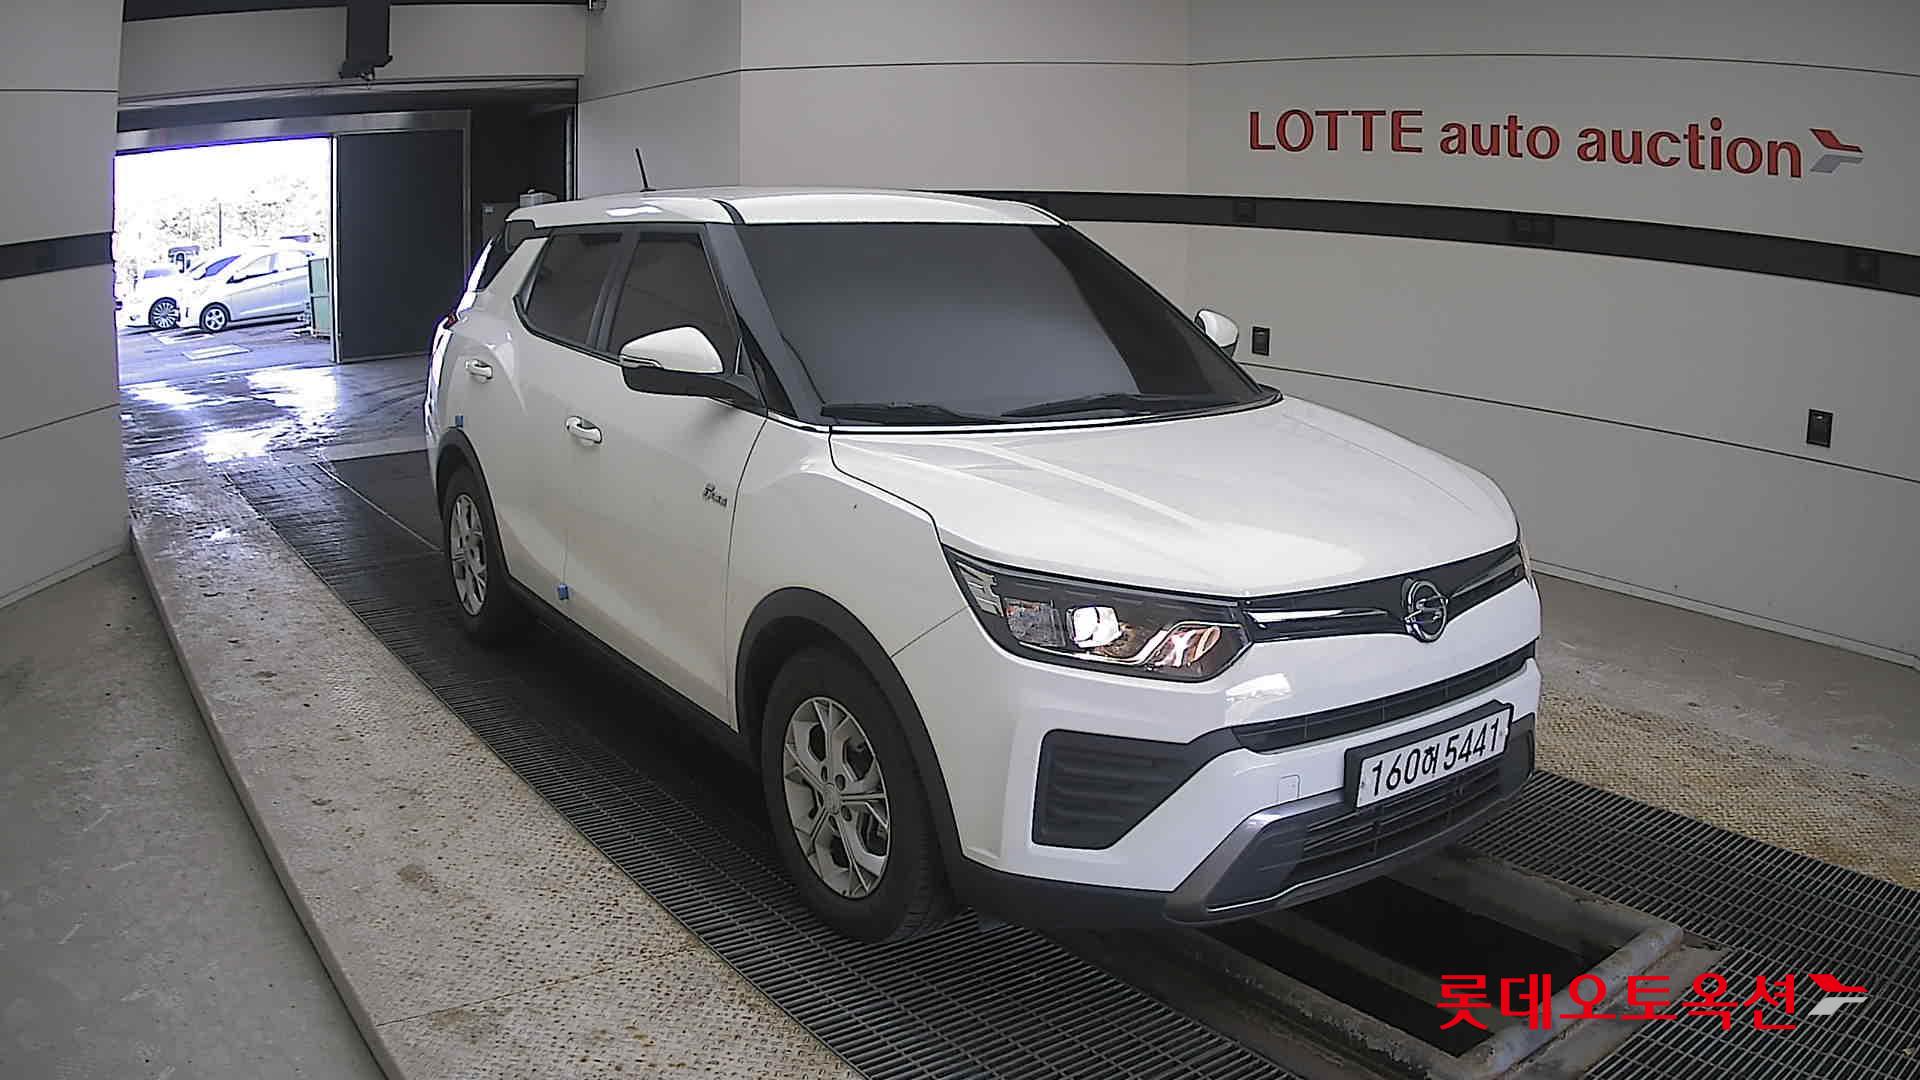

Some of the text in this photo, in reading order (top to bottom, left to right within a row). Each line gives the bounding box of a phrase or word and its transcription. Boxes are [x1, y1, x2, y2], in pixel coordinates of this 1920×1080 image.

[1249, 109, 1803, 179] LOTTE auto auction
